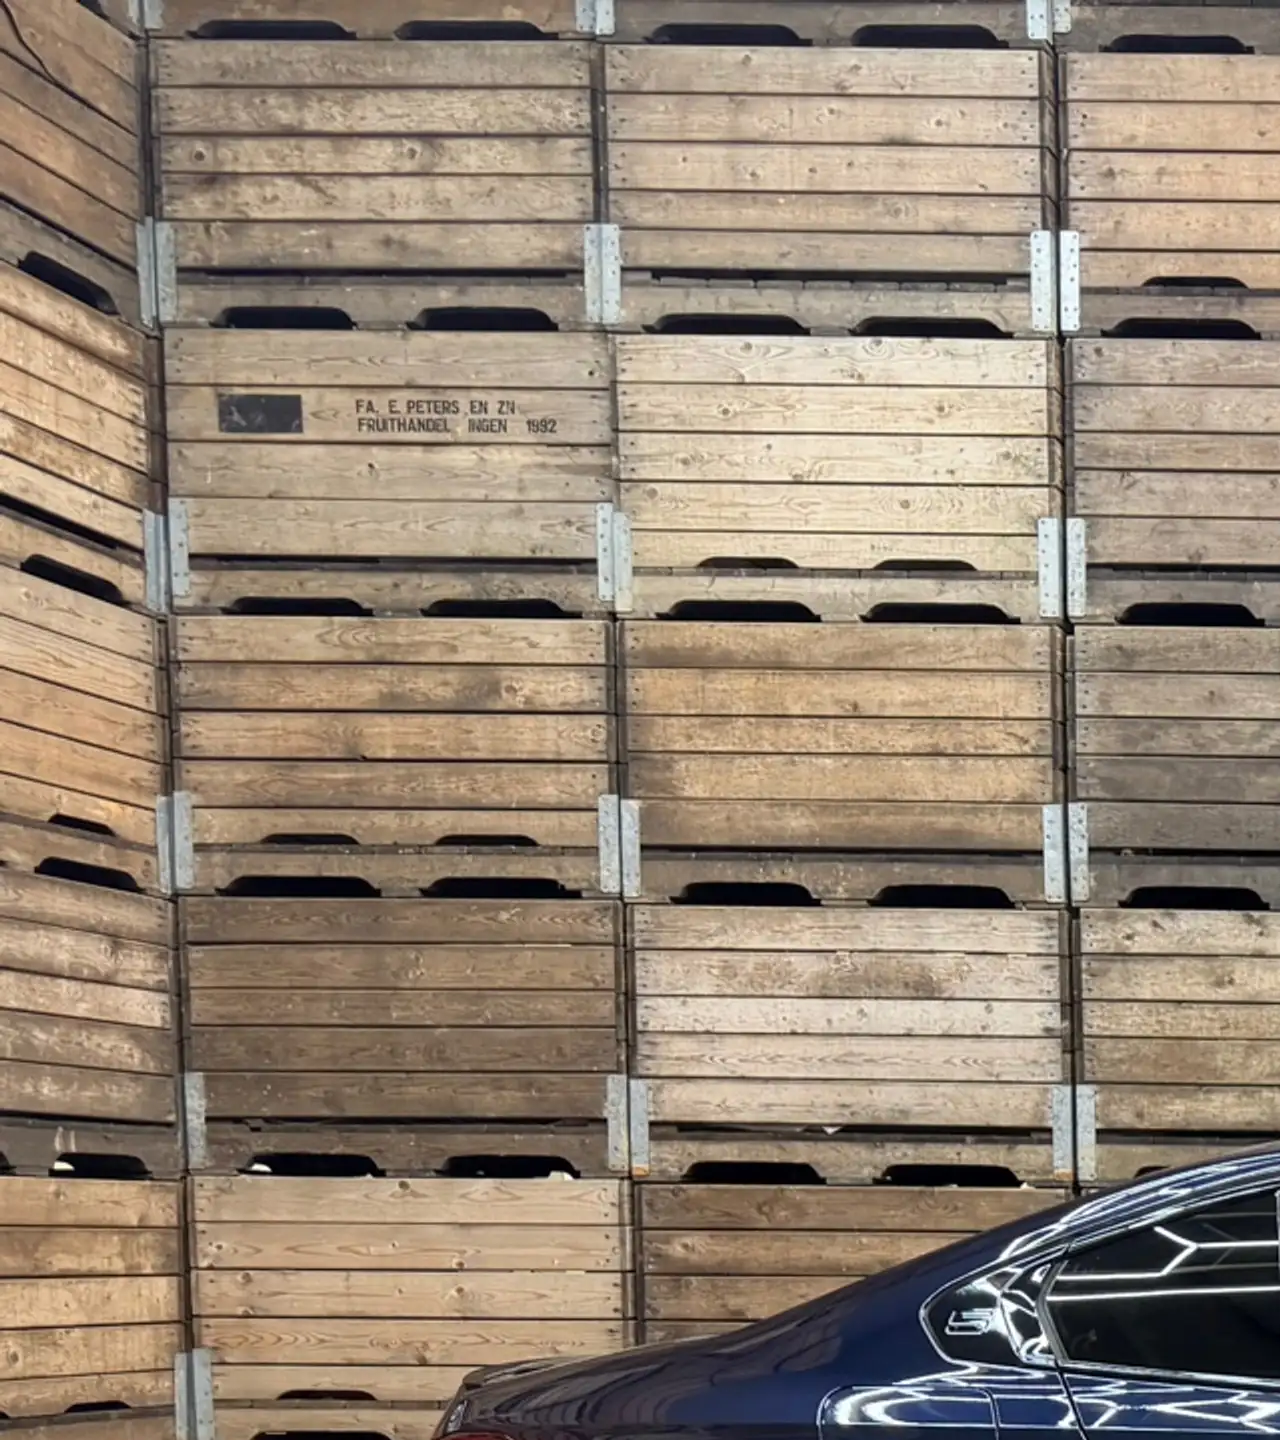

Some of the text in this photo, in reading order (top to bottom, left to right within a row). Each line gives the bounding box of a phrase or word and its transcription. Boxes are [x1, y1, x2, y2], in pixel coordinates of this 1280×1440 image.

[406, 399, 460, 416] PETERS
[469, 399, 489, 415] EN
[497, 399, 516, 415] ZN
[357, 417, 558, 434] FRUITHANDEL INGEN 1992
